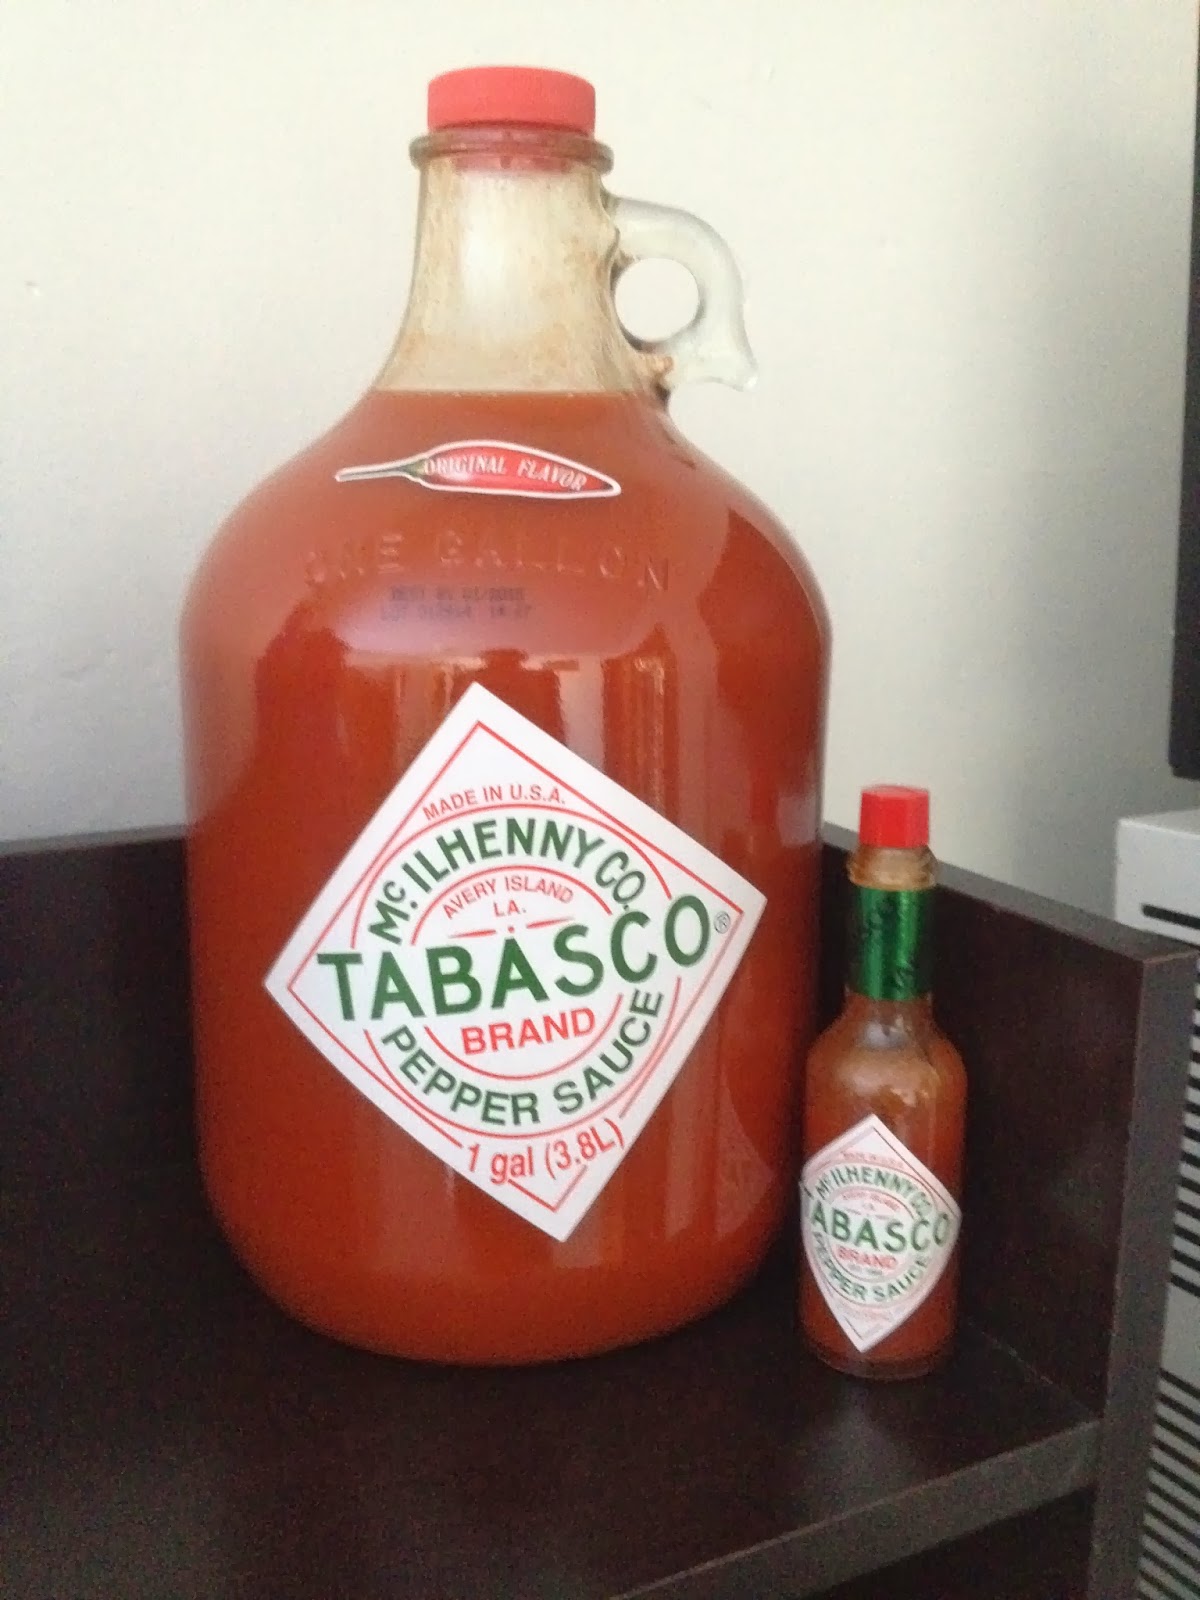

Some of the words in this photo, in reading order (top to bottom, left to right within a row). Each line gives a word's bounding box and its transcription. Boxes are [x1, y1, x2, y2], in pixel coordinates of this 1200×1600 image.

[423, 453, 508, 476] ORIGINAL
[517, 458, 587, 492] FLAVOR
[422, 788, 477, 820] MADE
[483, 785, 502, 802] IN
[509, 783, 566, 805] U.S.A.
[441, 879, 498, 920] AVERY
[504, 875, 575, 905] ISLAND
[493, 900, 527, 918] LA.
[316, 895, 711, 1022] TABASCO
[461, 1007, 596, 1056] BRAND
[381, 1024, 542, 1126] PEPPER
[553, 988, 665, 1116] SAUCE
[467, 1143, 481, 1173] 1
[490, 1146, 534, 1185] gal
[544, 1117, 626, 1180] (3.8L)
[837, 1244, 898, 1269] BRAND
